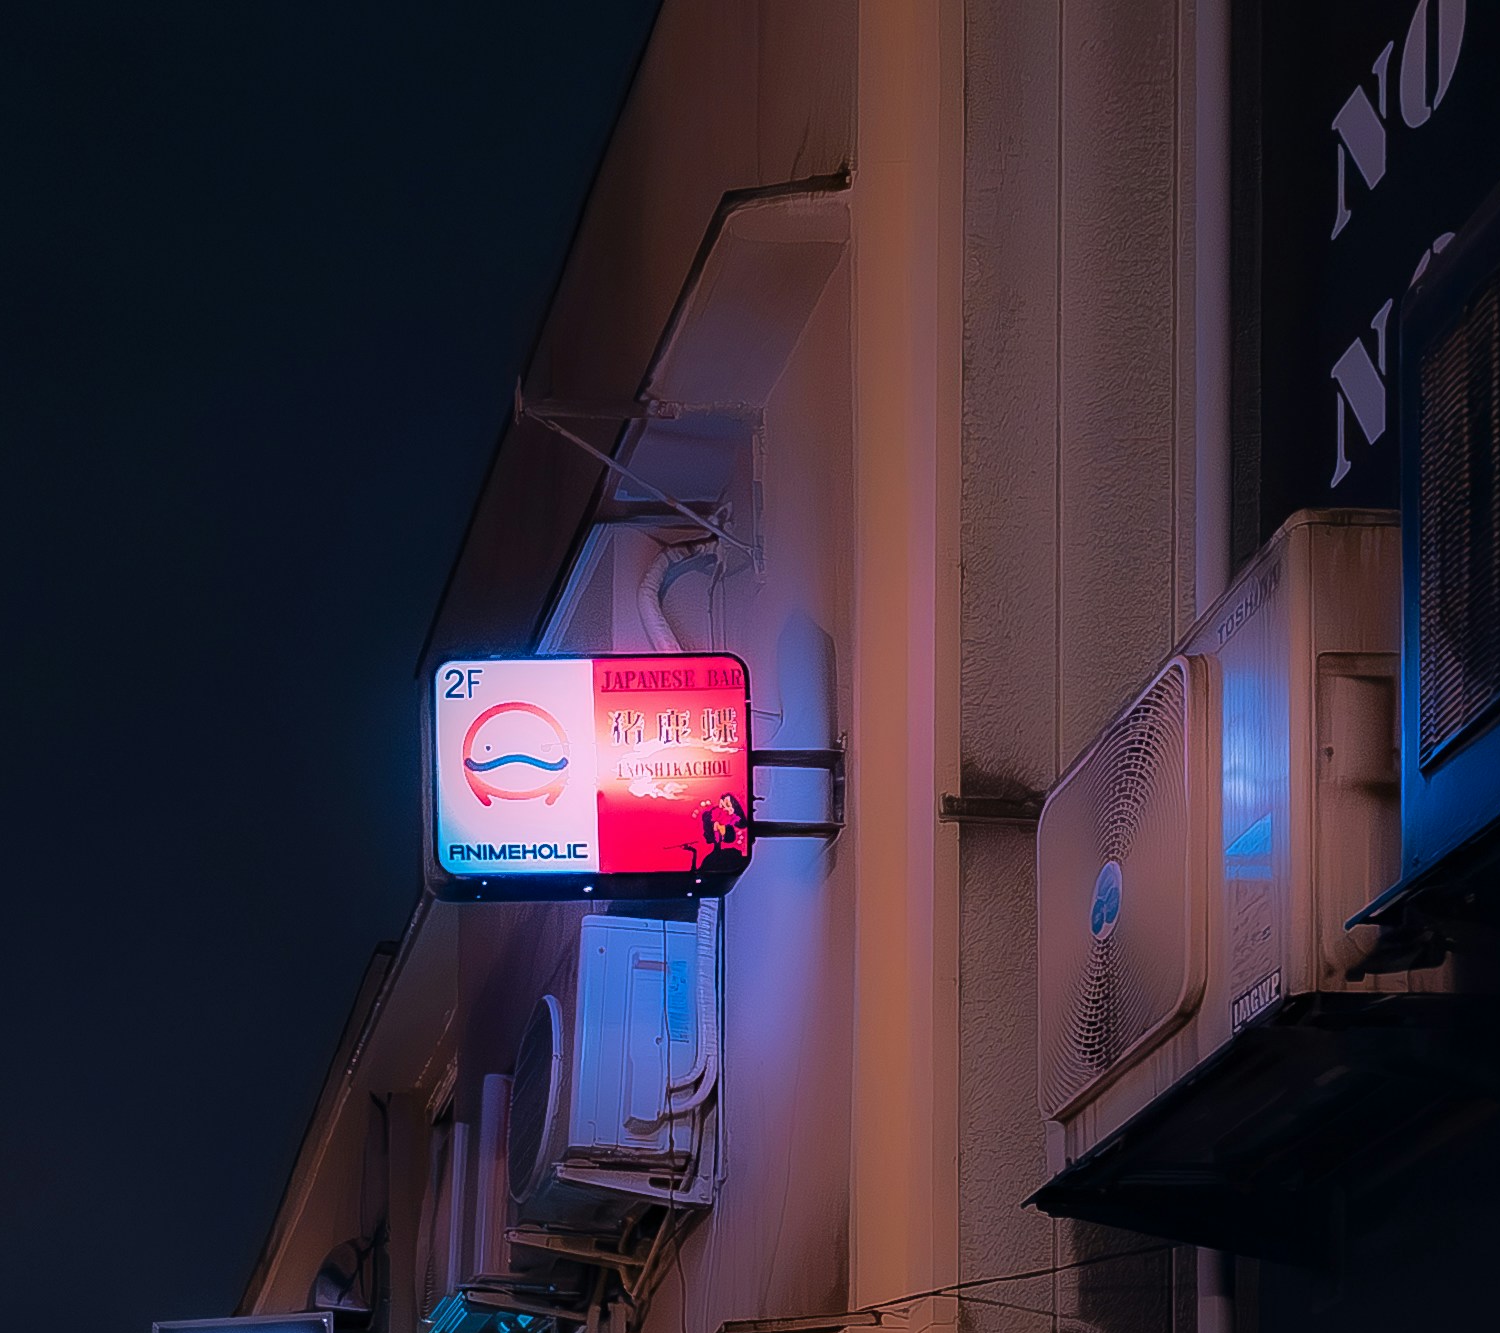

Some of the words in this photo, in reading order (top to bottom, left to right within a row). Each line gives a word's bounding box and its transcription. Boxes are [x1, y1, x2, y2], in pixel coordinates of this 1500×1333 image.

[444, 668, 484, 699] 2F
[600, 669, 696, 692] JAPANESE
[706, 668, 743, 690] BAR
[449, 843, 589, 861] ANIMEHOLIC
